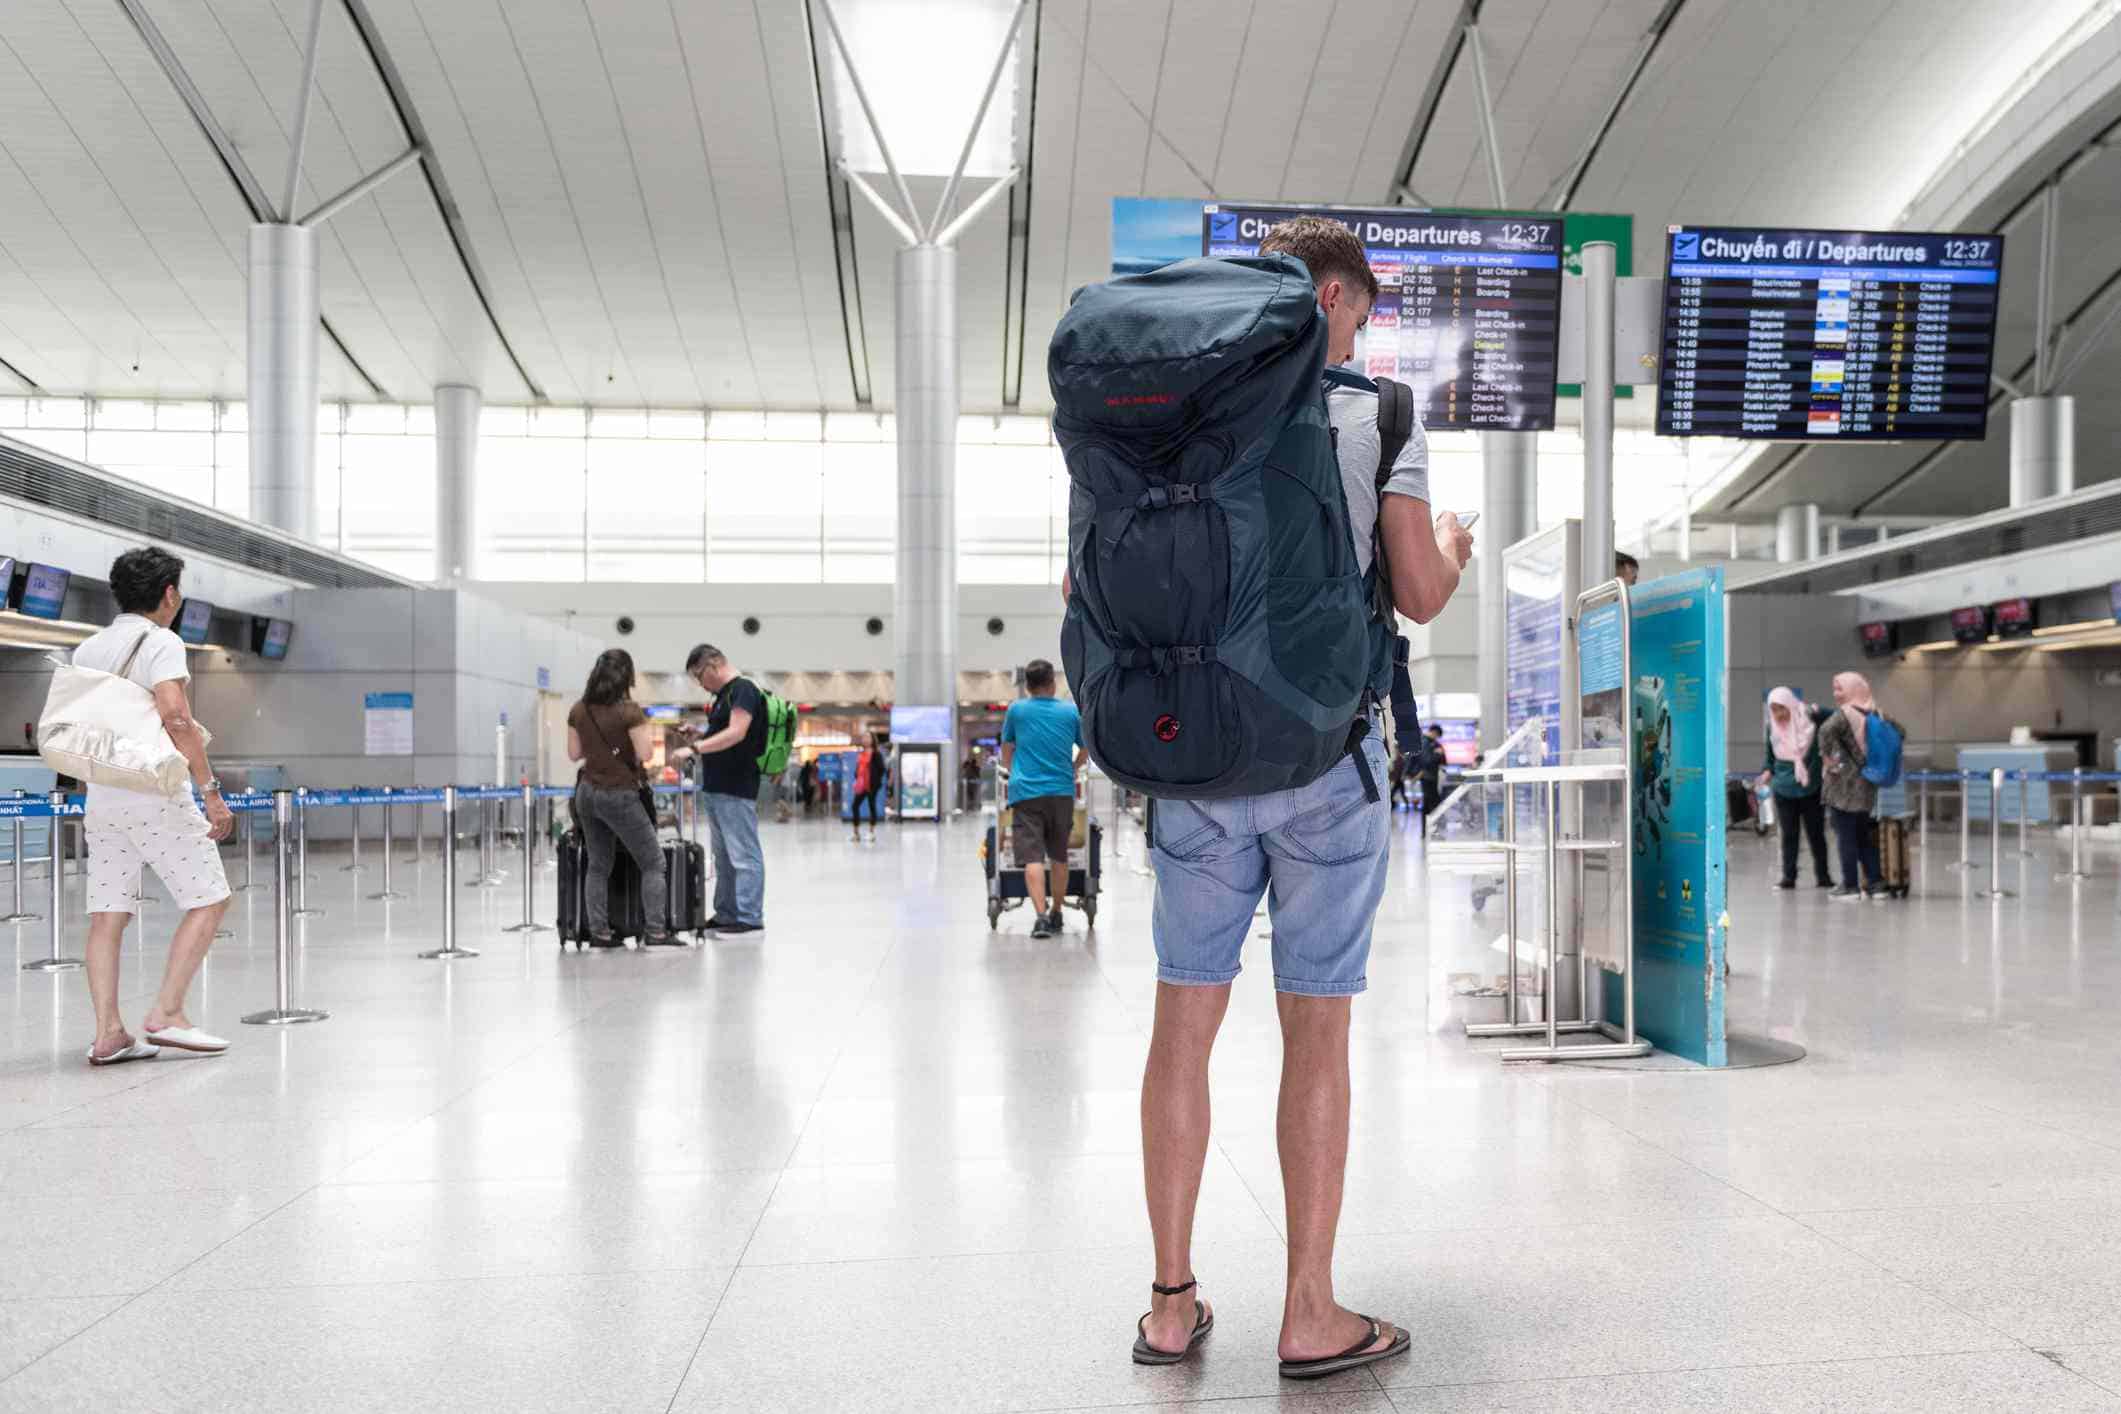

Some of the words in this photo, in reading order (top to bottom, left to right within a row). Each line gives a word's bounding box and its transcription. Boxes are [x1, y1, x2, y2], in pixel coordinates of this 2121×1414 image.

[1366, 223, 1482, 247] Departures
[1502, 224, 1550, 243] 12:37
[1806, 239, 1813, 260] /
[1818, 241, 1926, 264] Departures
[1944, 240, 1990, 259] 12:37
[1477, 267, 1493, 276] Last
[1495, 268, 1528, 276] Check-in
[1417, 276, 1433, 284] 732
[1476, 277, 1511, 288] Boarding
[1403, 287, 1415, 295] EY
[1476, 288, 1510, 299] Boarding
[1417, 308, 1432, 316] 177
[1475, 309, 1509, 320] Boarding
[1475, 320, 1492, 328] Last
[1493, 320, 1526, 329] Check-in
[1474, 330, 1508, 339] Check-in
[1473, 351, 1507, 362] Boarding
[1491, 362, 1524, 371] Check-in
[1472, 383, 1488, 391] Last
[1490, 384, 1523, 392] Check-in
[1765, 382, 1792, 391] Lumpur
[1472, 393, 1505, 402] Check-in
[1471, 404, 1504, 412] Check-in
[1471, 414, 1487, 422] Last
[249, 798, 274, 808] AIRPO
[49, 804, 84, 815] TIA
